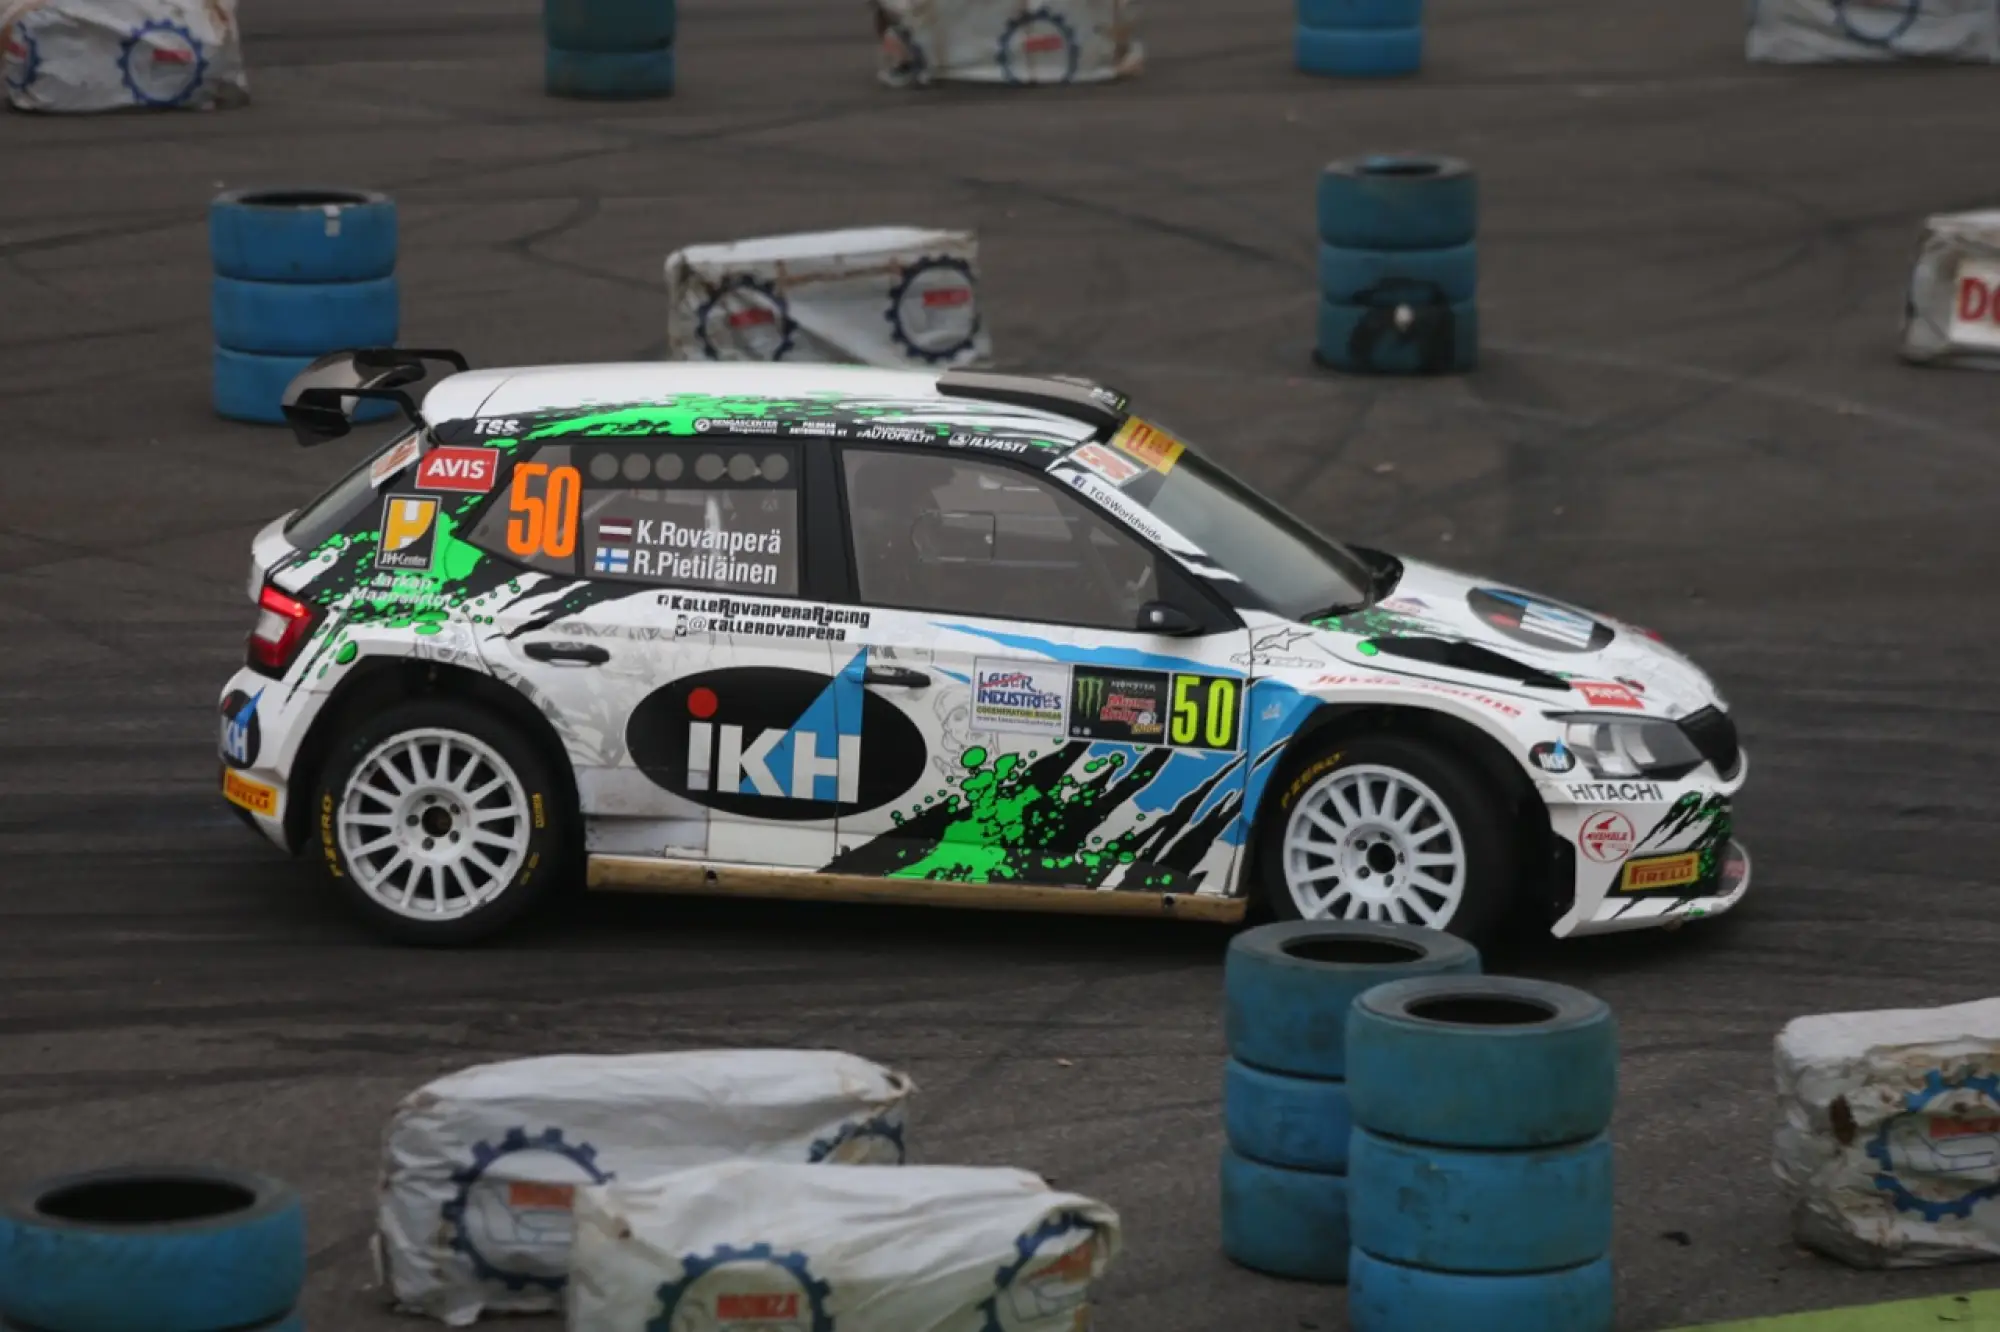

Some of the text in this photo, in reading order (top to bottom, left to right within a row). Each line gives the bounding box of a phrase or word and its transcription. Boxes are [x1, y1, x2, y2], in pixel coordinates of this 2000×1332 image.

[1957, 276, 2000, 324] D
[427, 458, 486, 479] AVIS
[507, 462, 581, 559] 50
[1089, 485, 1162, 541] TGSWorldwide
[636, 519, 782, 555] K.Rovanperä
[633, 549, 778, 585] R.Pietiläinen
[1172, 675, 1235, 748] 50
[1568, 782, 1663, 801] HITACHI
[1630, 857, 1693, 885] PIRELLI
